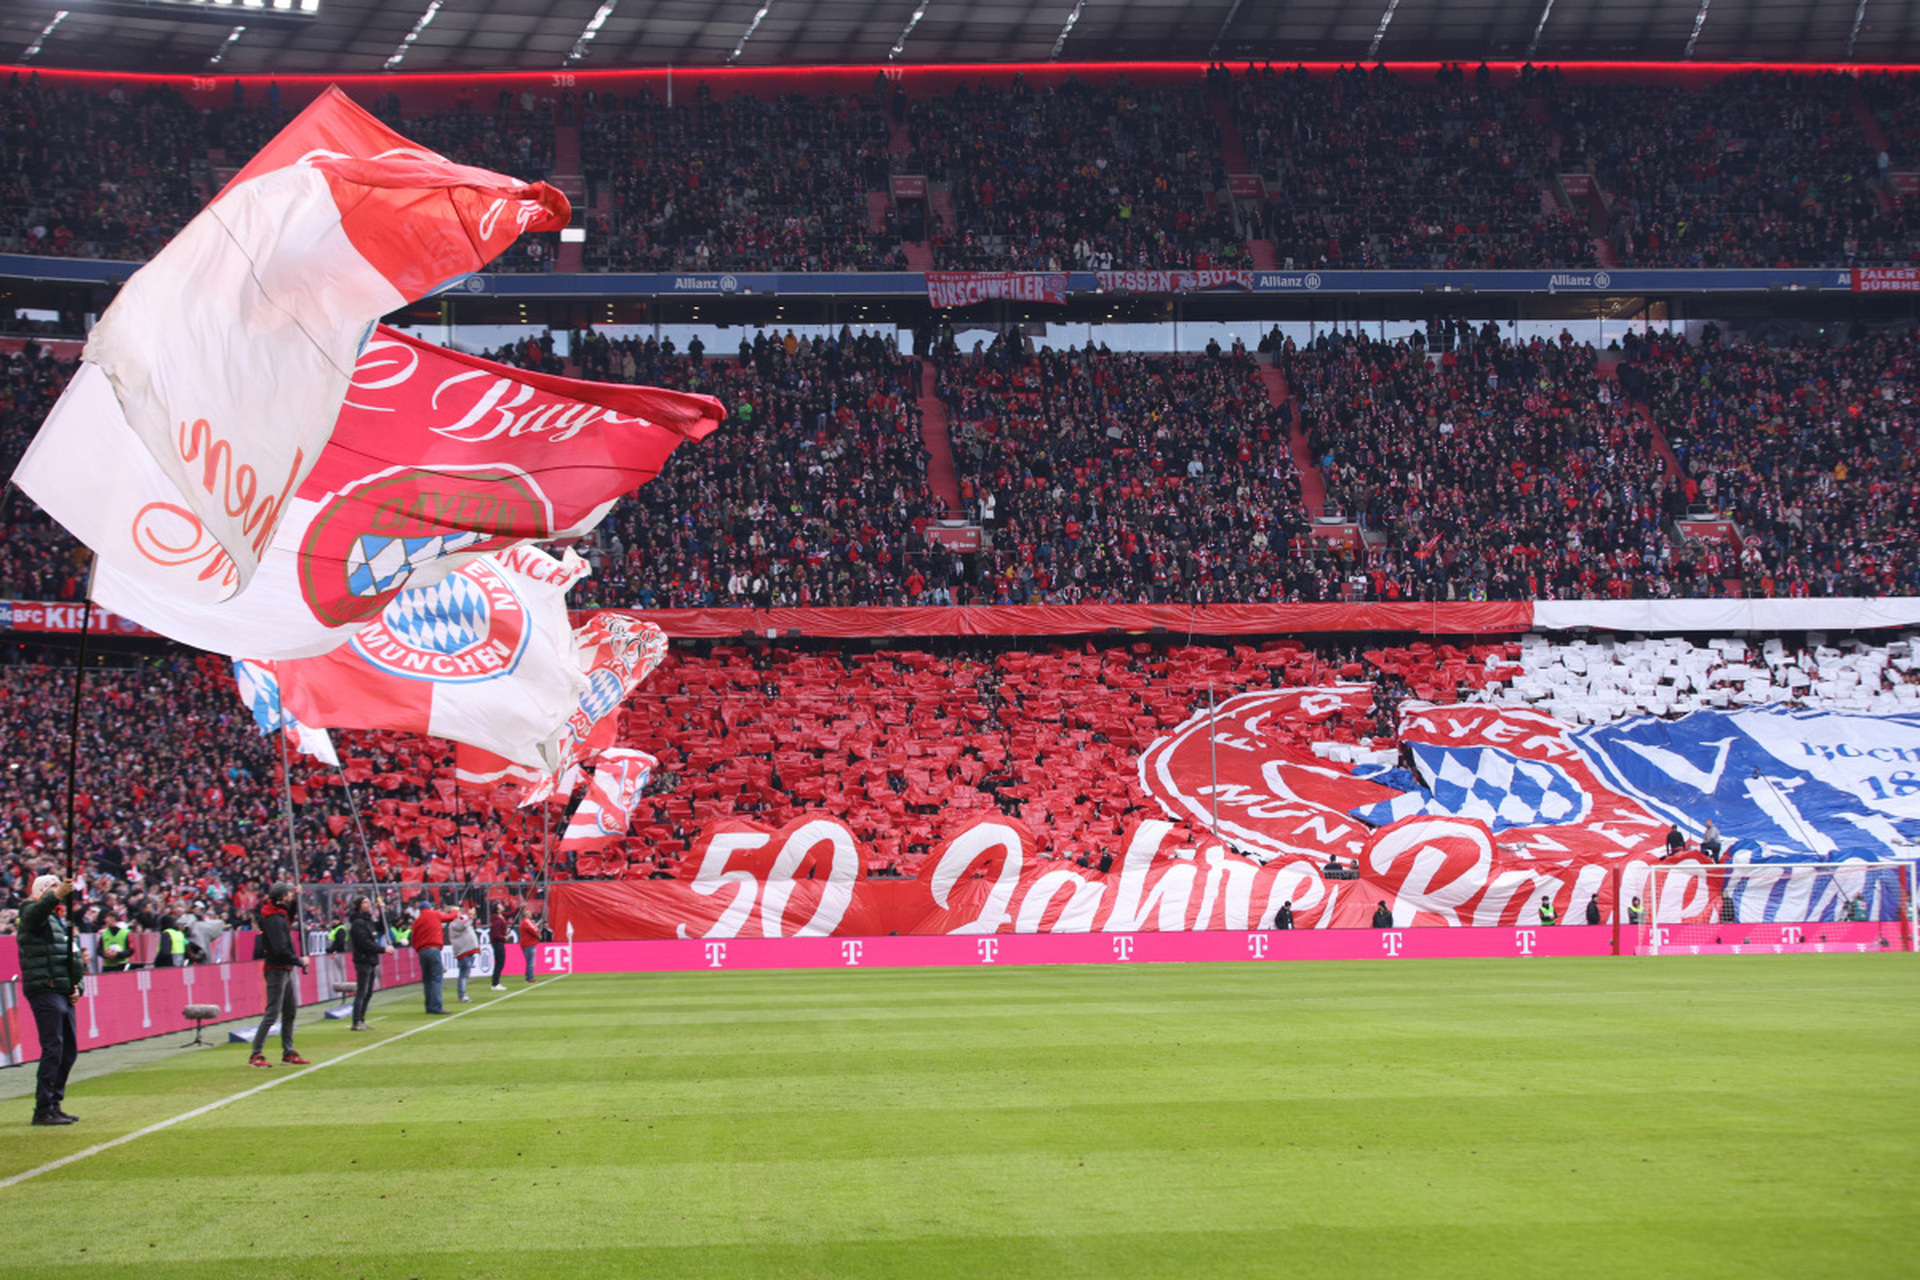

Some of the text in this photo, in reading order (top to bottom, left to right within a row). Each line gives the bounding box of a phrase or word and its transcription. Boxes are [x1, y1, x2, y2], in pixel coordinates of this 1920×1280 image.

[552, 74, 575, 87] 318
[674, 277, 718, 289] Allianz
[1097, 270, 1172, 292] GIESSEN
[1260, 275, 1303, 288] Allianz
[1549, 274, 1592, 286] Allianz
[45, 607, 112, 630] KIST
[359, 621, 512, 676] MÜNCHEN
[677, 820, 861, 938] 50
[842, 941, 862, 965] T
[978, 938, 998, 962] T
[1113, 936, 1133, 960] T
[1248, 934, 1268, 958] T
[1382, 932, 1402, 956] T
[1516, 930, 1536, 954] T
[544, 946, 570, 970] T
[705, 943, 726, 967] T
